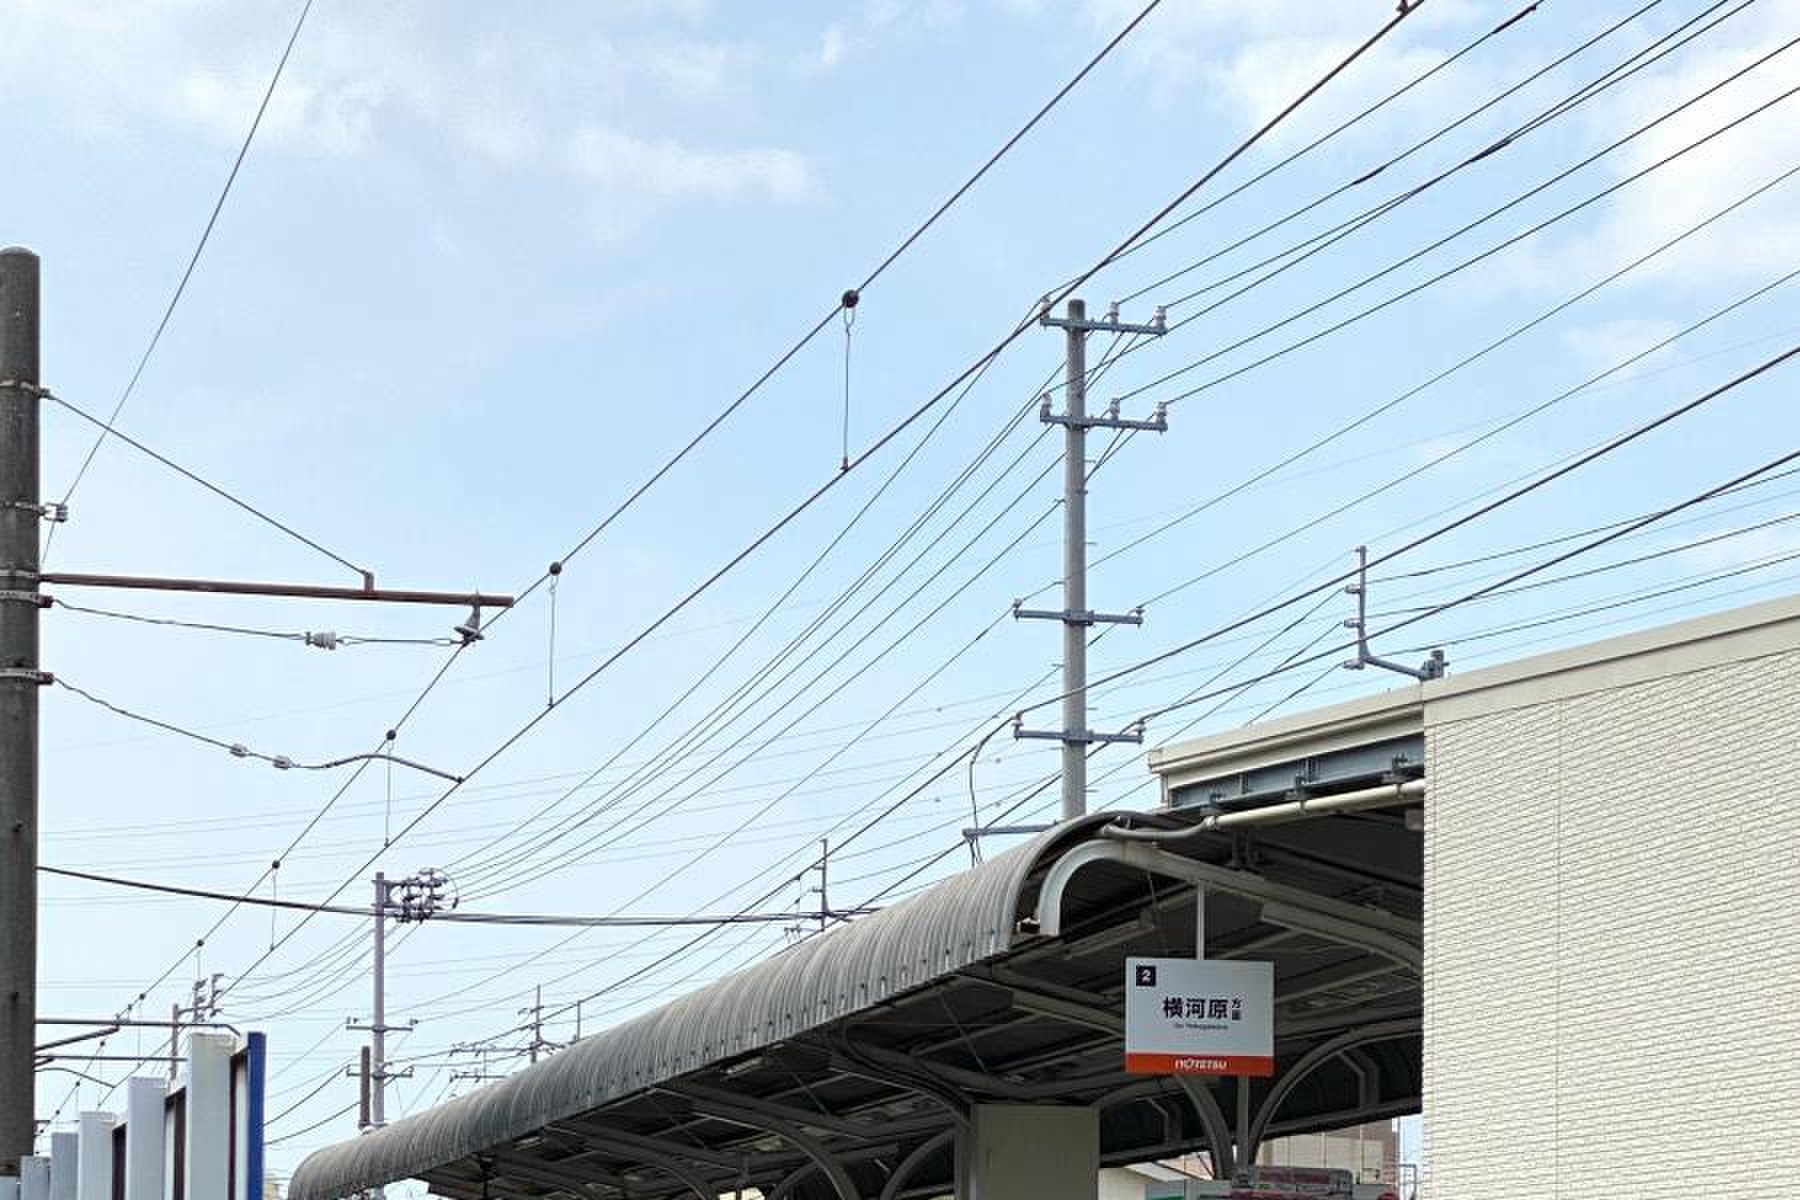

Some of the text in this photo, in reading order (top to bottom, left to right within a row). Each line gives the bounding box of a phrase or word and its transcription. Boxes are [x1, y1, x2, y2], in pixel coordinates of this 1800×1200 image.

[1141, 969, 1151, 982] 2
[1163, 996, 1228, 1019] 横河原
